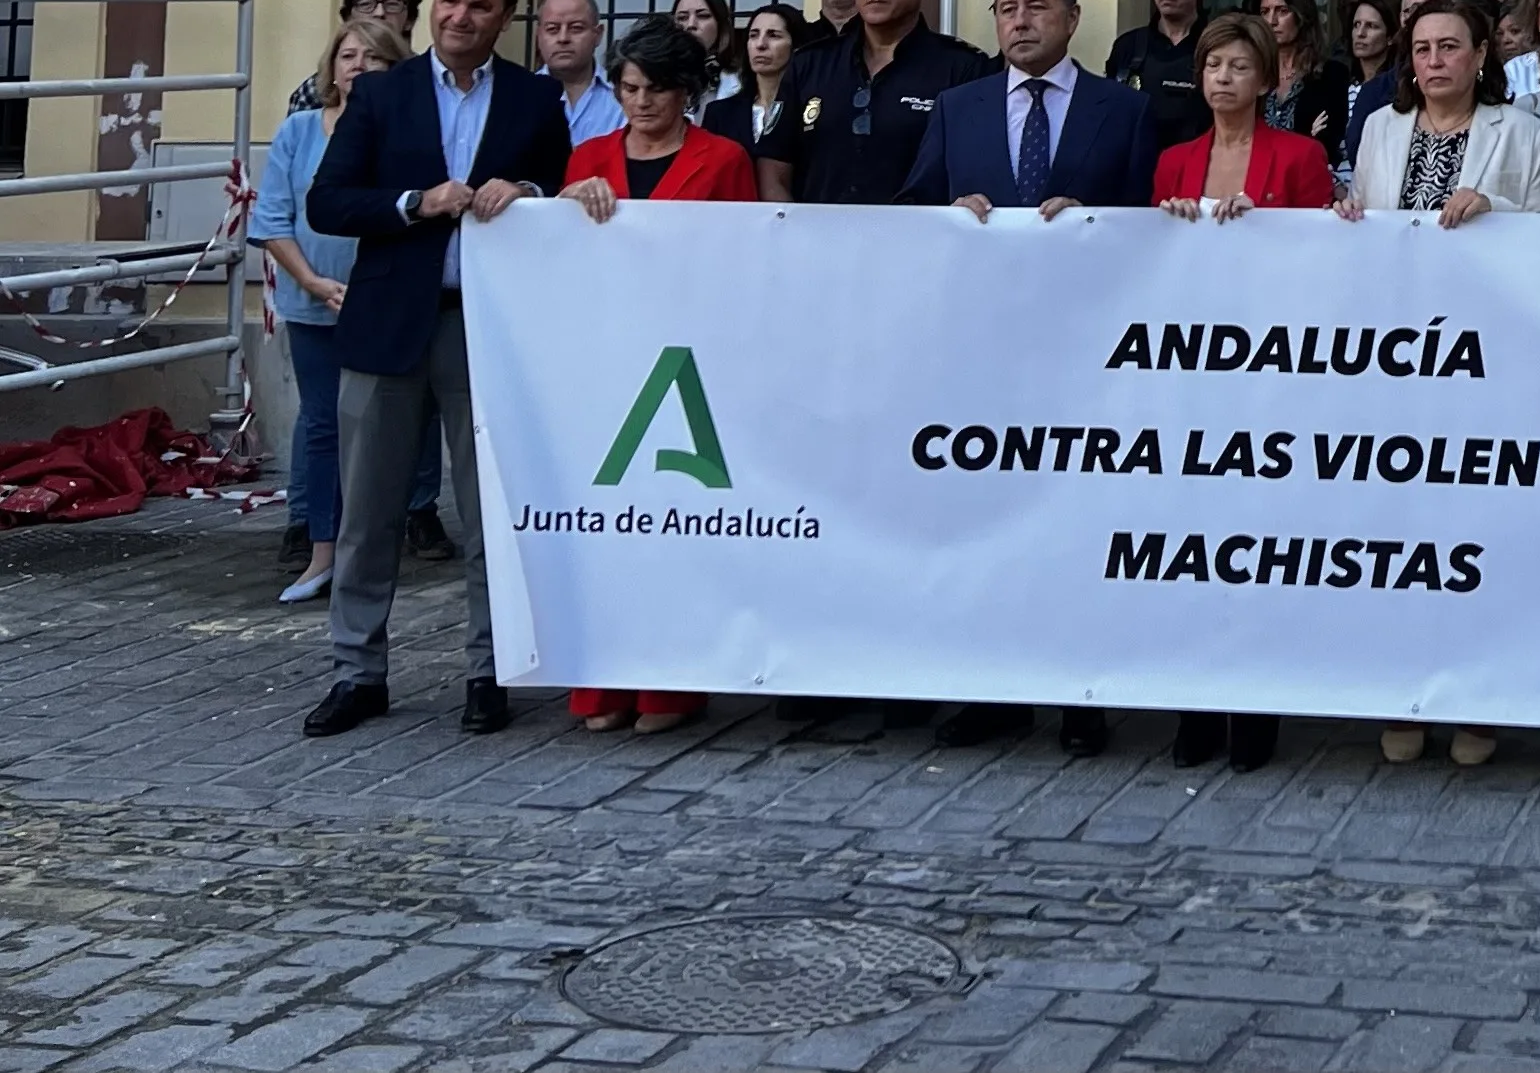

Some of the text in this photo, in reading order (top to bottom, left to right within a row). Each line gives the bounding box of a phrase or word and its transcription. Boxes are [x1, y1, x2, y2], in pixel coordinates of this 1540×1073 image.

[1104, 316, 1486, 379] ANDALUCÍA
[911, 424, 1163, 475] CONTRA
[1181, 429, 1296, 480] LAS
[513, 504, 820, 539] Junta de Andalucía
[1104, 531, 1485, 593] MACHISTAS
